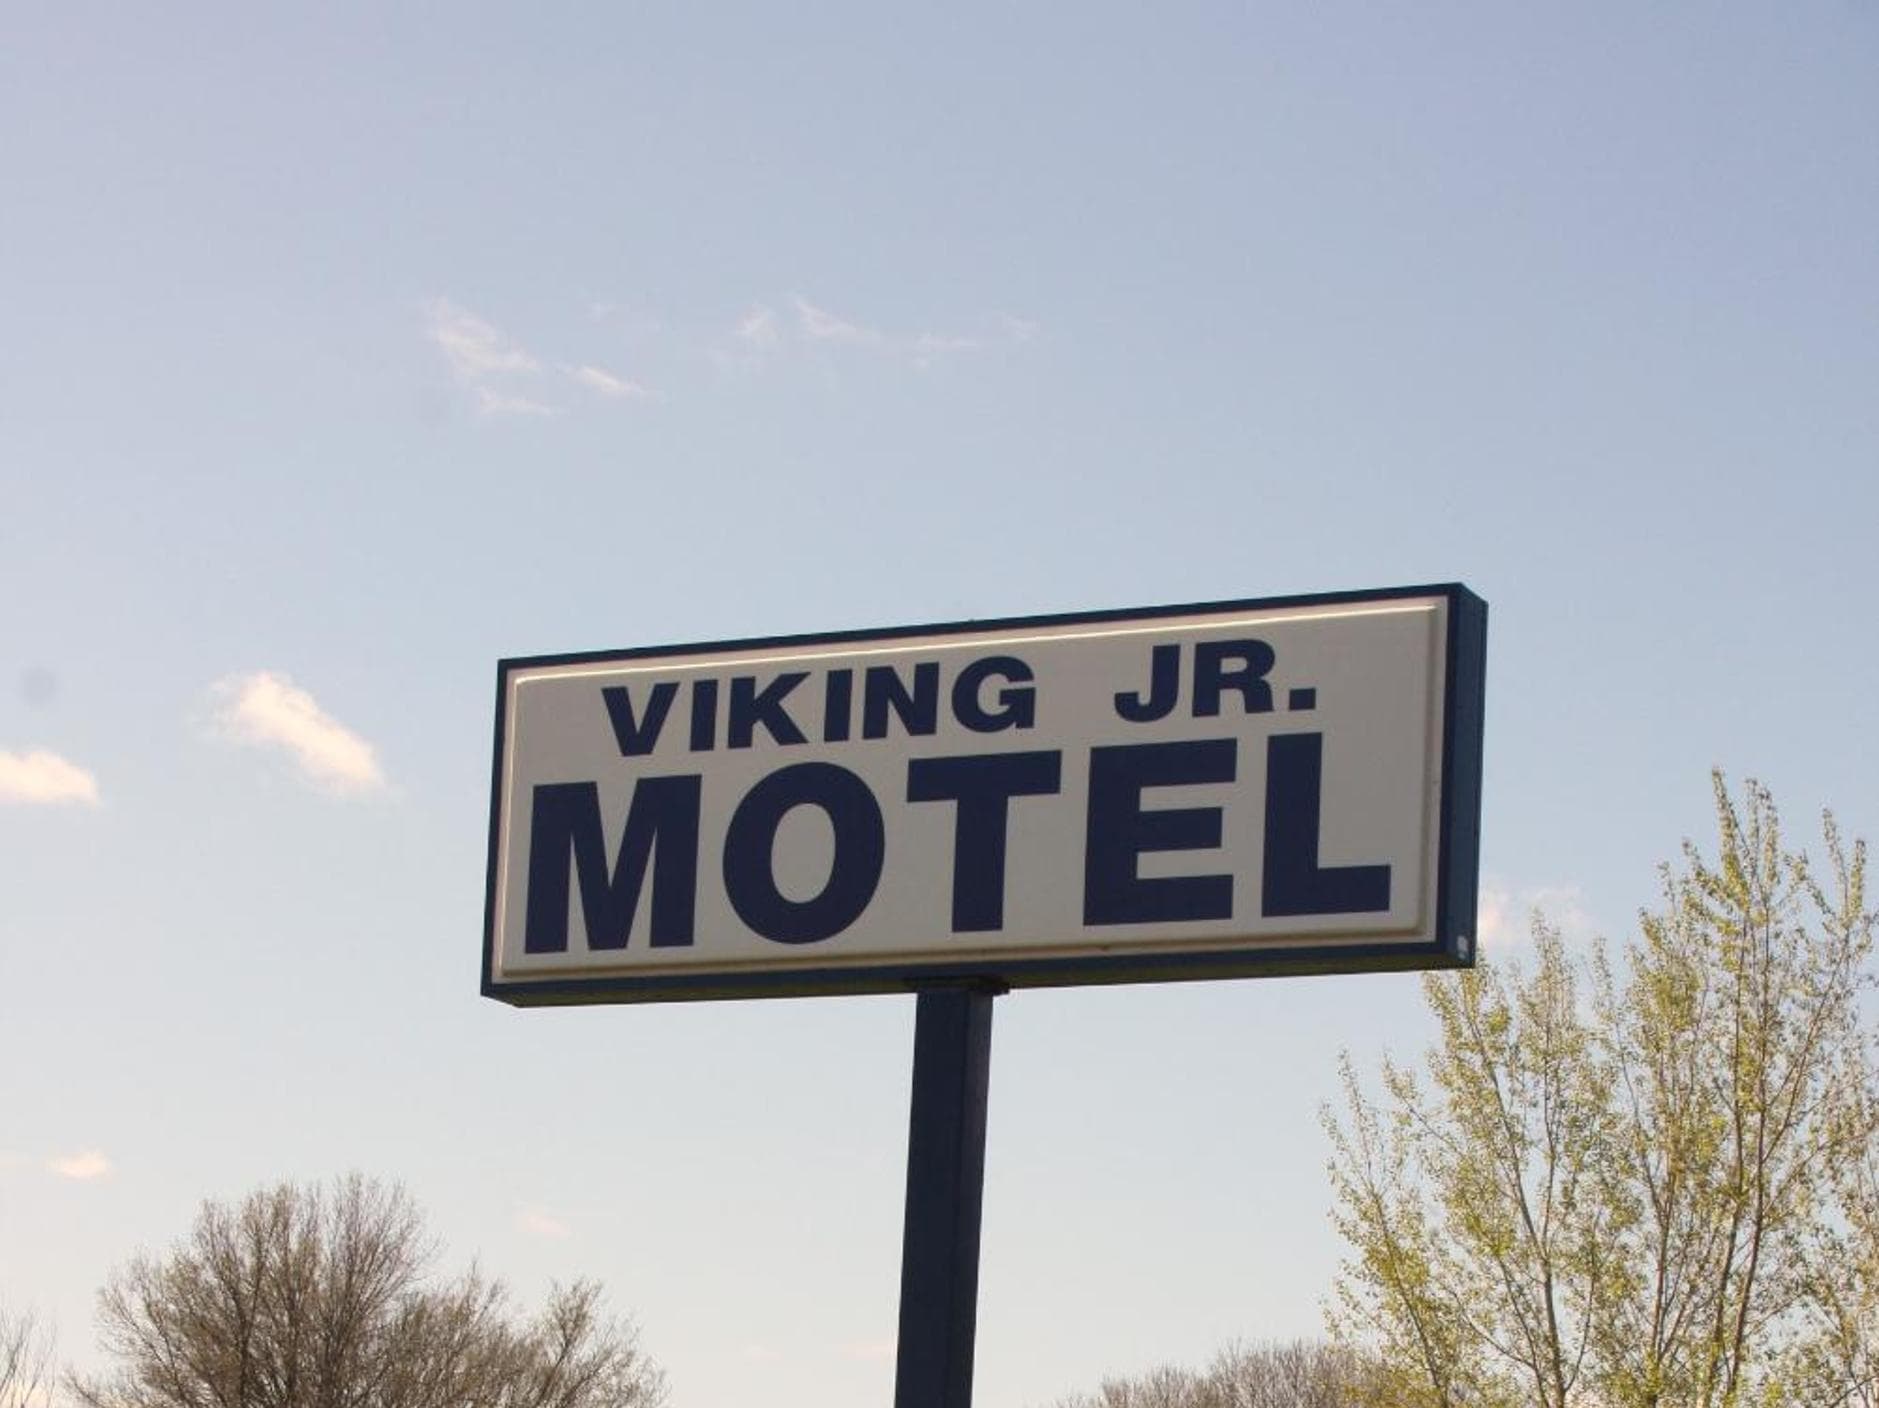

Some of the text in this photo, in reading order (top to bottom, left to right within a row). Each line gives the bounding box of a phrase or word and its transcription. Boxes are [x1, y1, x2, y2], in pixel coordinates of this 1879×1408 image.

[600, 638, 1318, 757] VIKING JR.
[524, 732, 1392, 955] MOTEL
